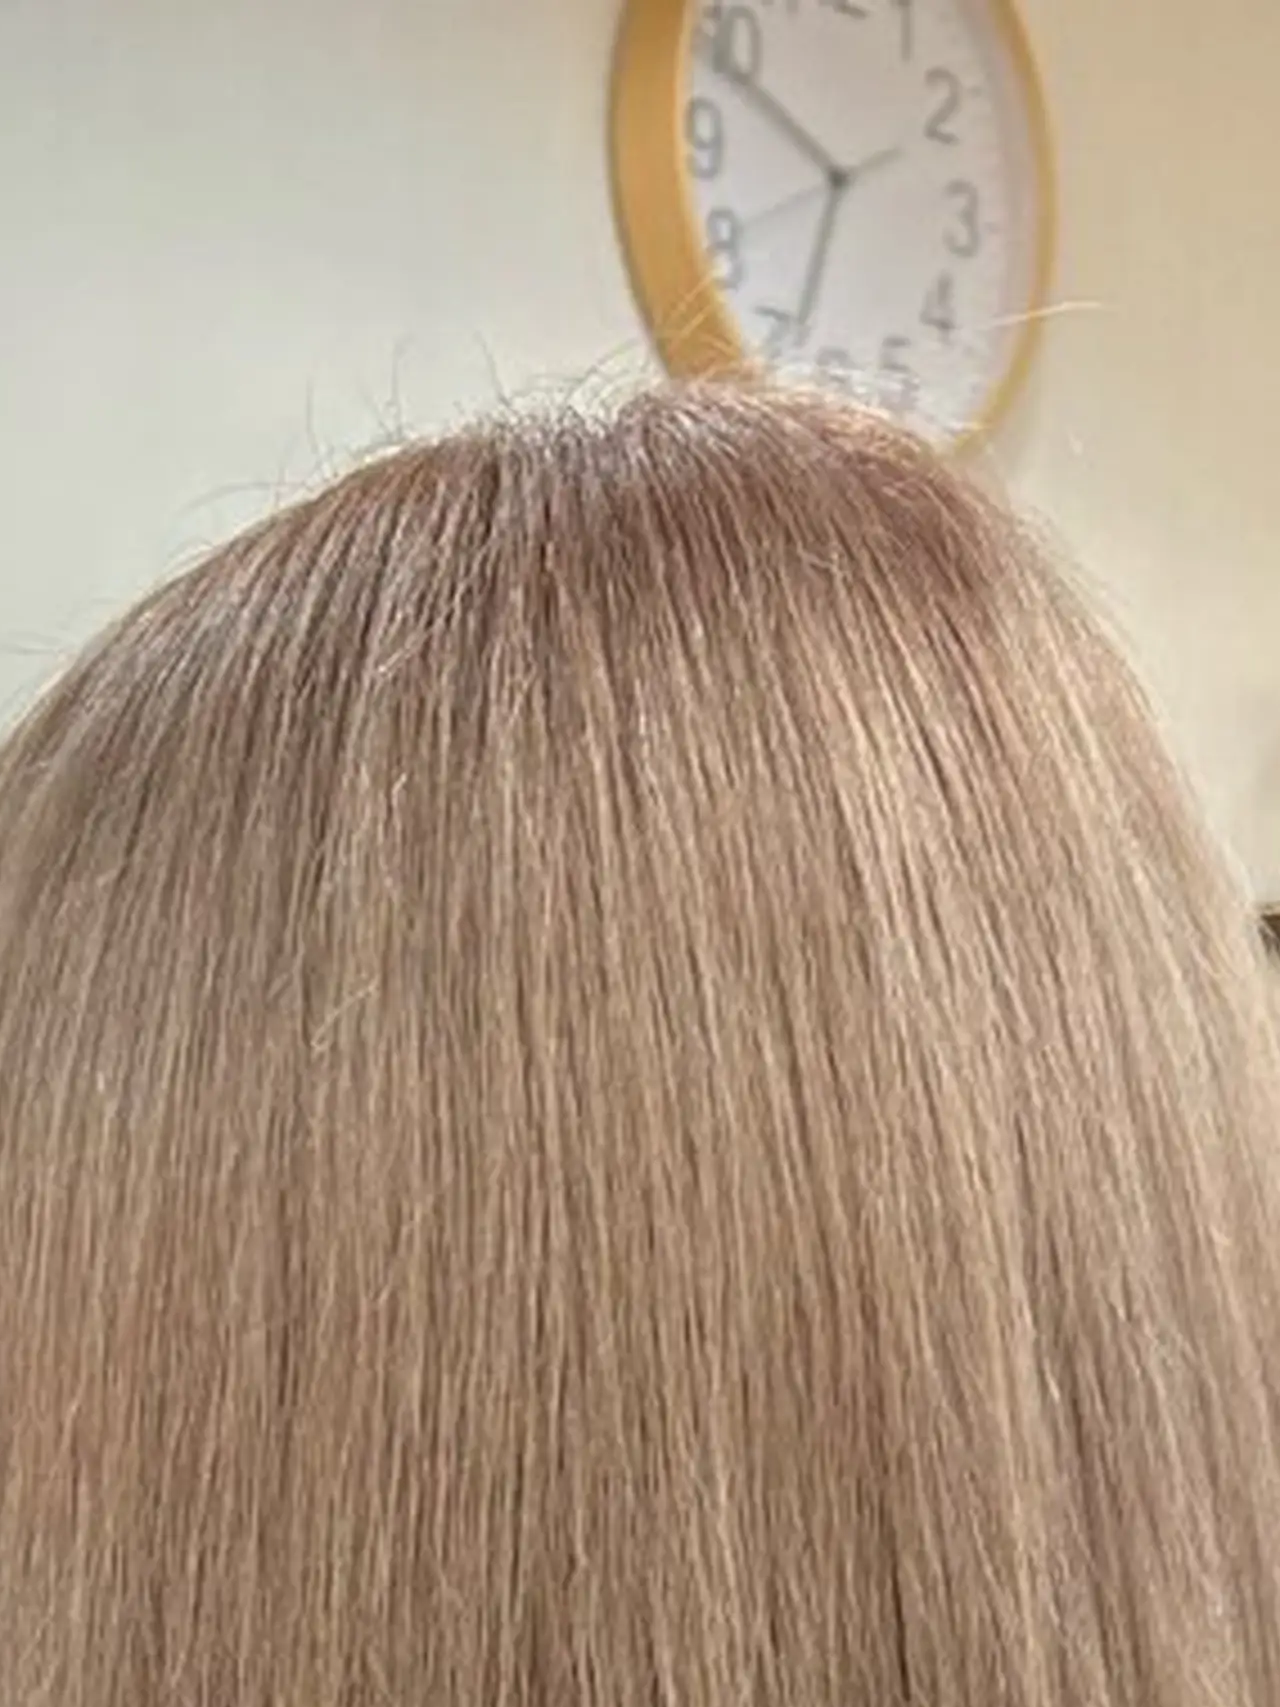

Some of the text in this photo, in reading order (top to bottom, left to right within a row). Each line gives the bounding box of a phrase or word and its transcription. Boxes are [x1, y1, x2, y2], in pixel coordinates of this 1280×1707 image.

[687, 97, 724, 180] 9
[923, 66, 962, 144] 2
[705, 207, 743, 290] 8
[941, 179, 980, 258] 3
[919, 272, 960, 345] 4
